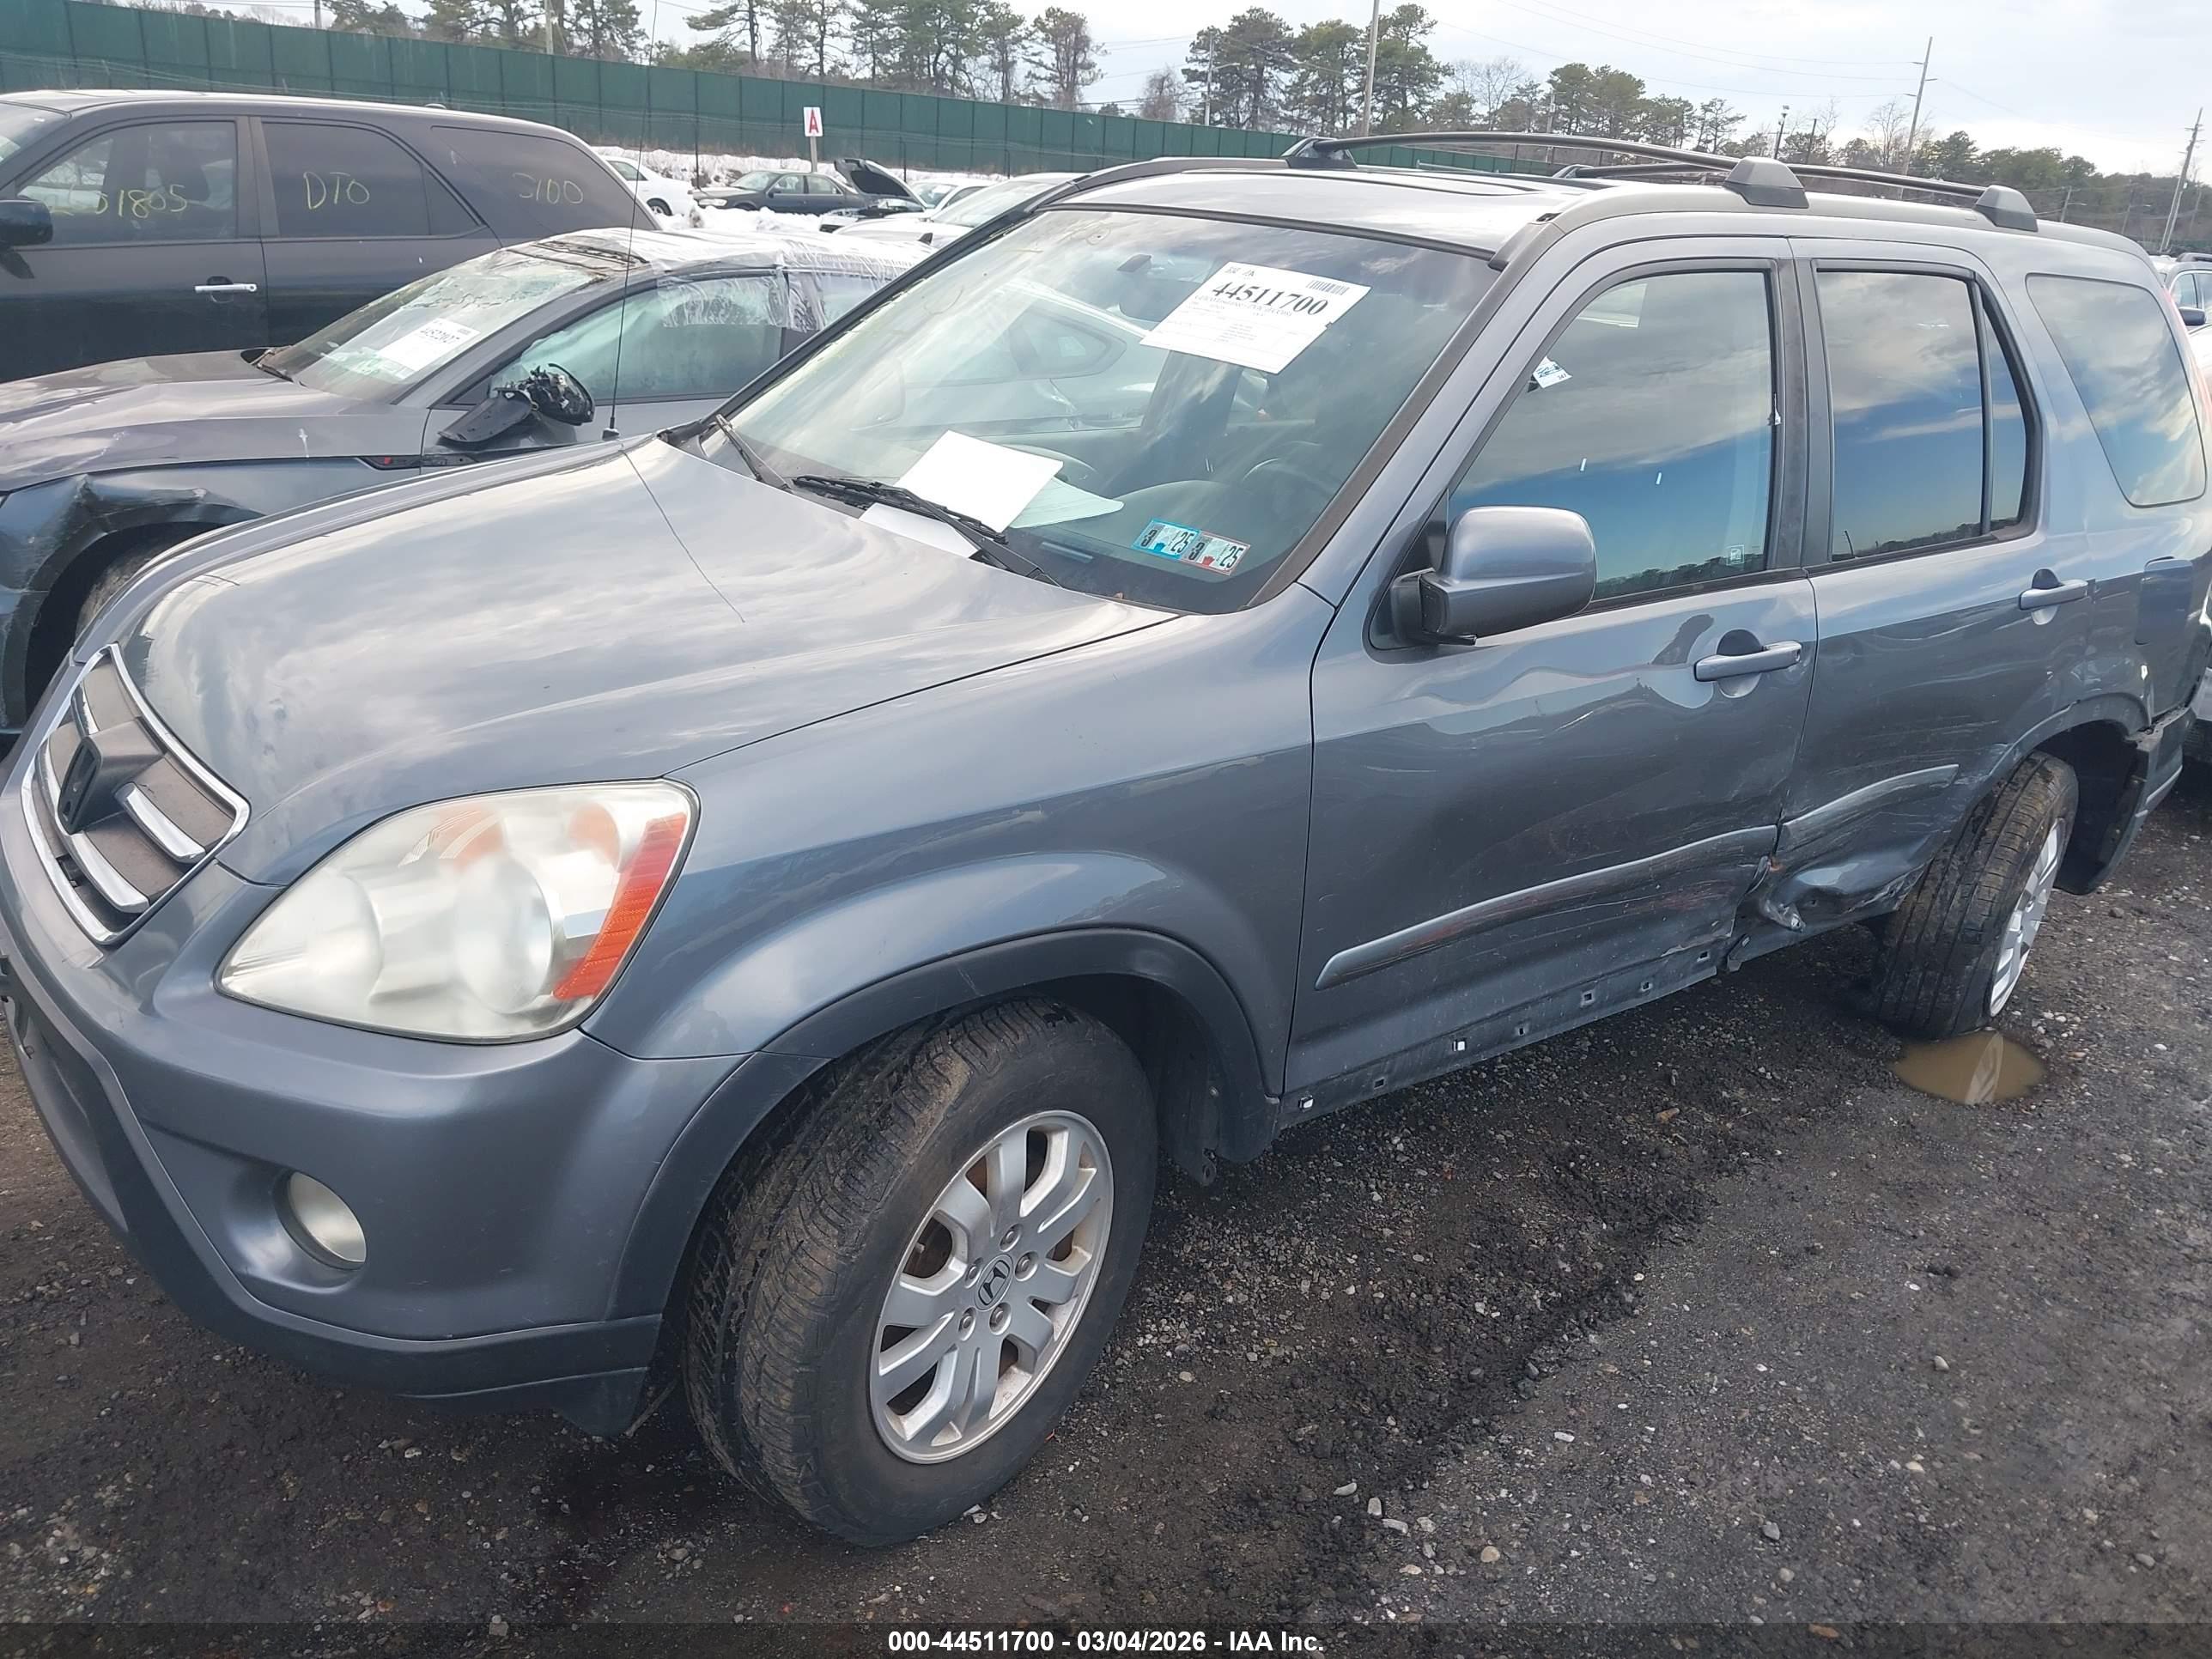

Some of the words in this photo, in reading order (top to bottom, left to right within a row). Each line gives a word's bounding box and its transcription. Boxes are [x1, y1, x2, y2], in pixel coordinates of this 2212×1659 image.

[809, 108, 819, 133] A
[1212, 281, 1329, 316] 44511700
[1170, 531, 1194, 554] 25
[1219, 545, 1244, 568] 25
